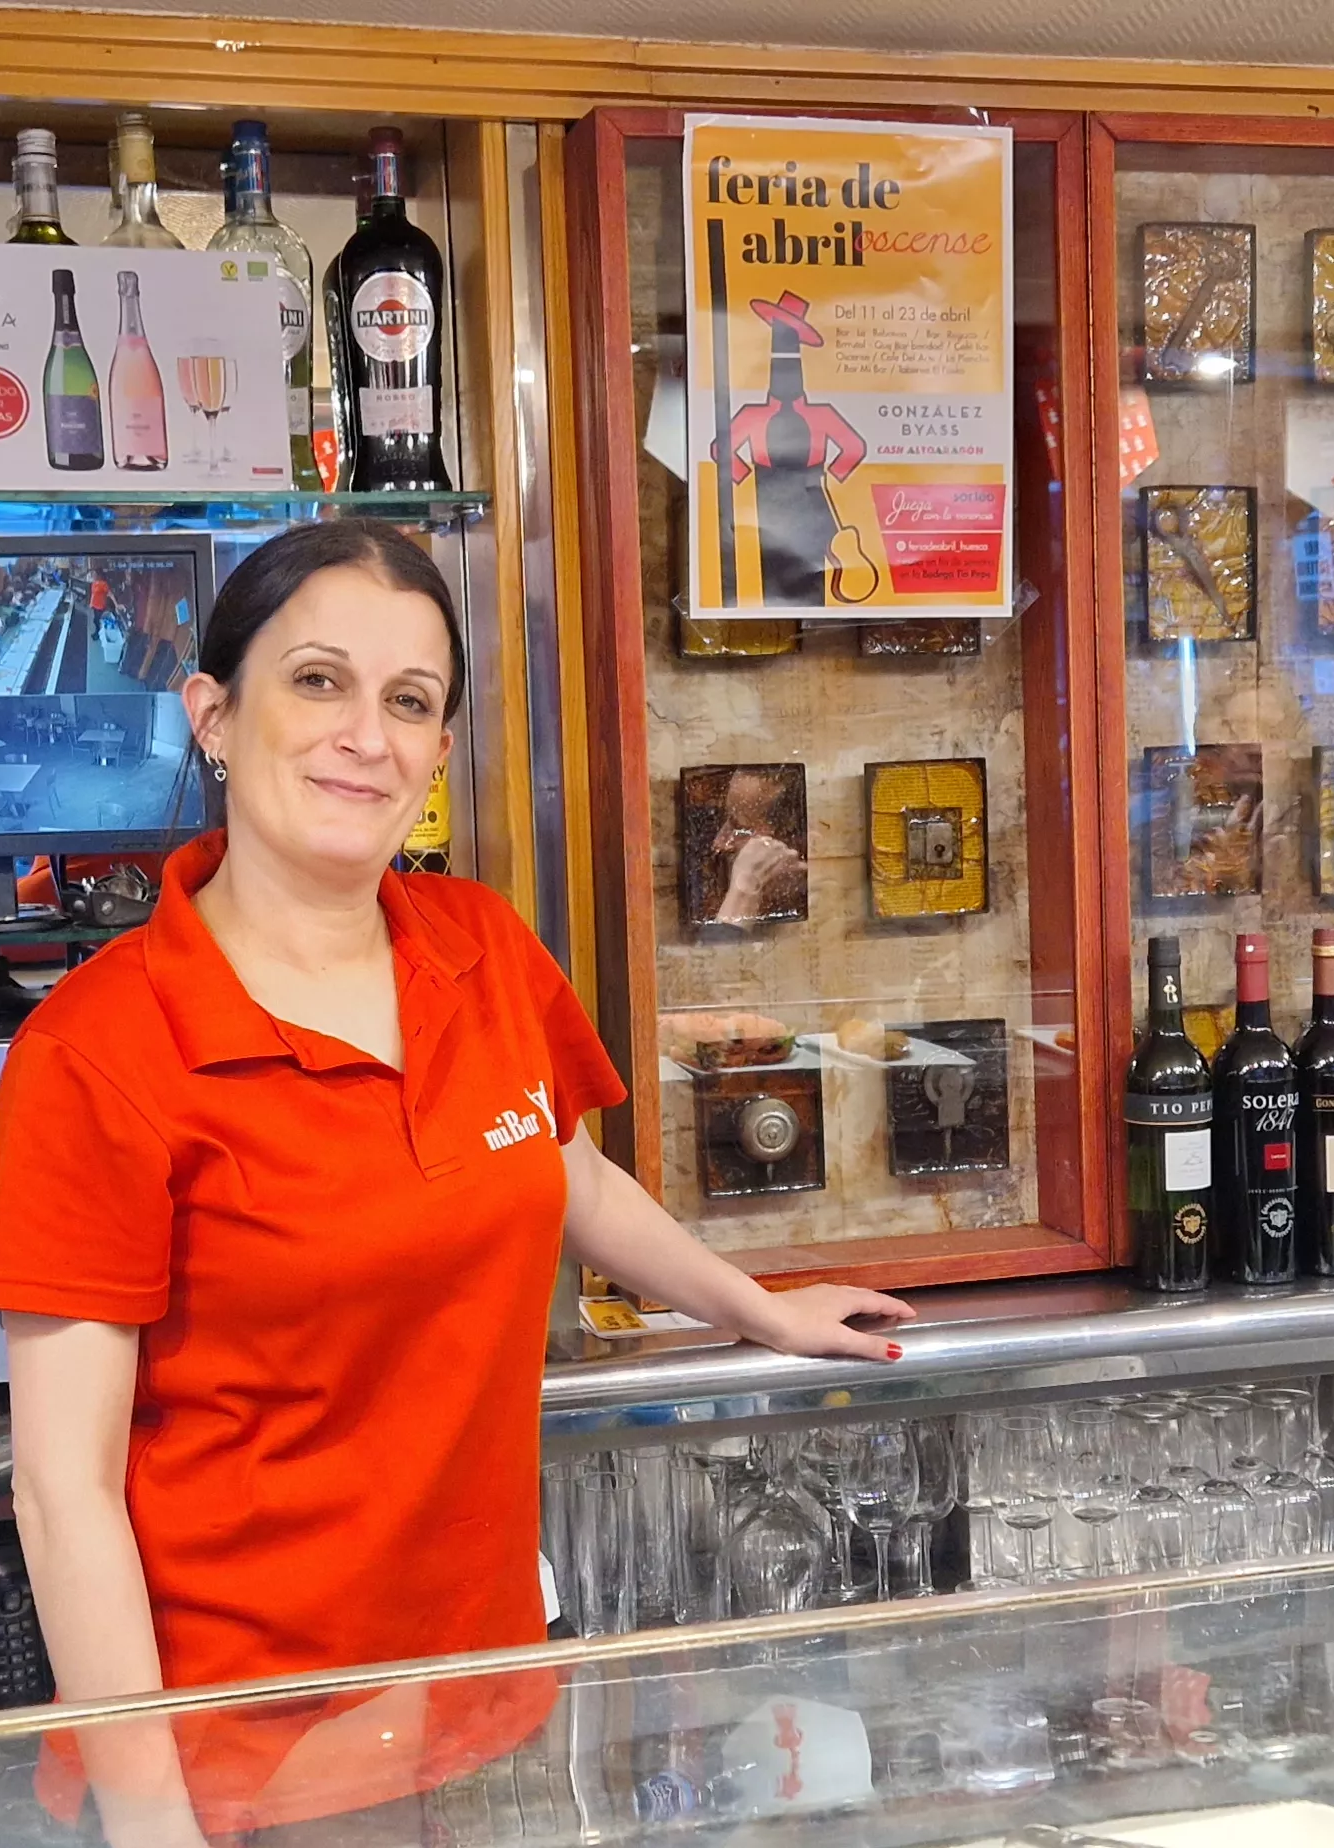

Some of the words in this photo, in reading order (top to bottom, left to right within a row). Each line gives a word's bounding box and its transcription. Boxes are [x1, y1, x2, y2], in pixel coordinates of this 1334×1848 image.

[705, 155, 831, 208] feria
[841, 162, 901, 210] de
[741, 218, 866, 267] abril
[853, 228, 992, 255] oscense
[358, 309, 427, 327] MARTINI
[835, 304, 856, 319] Del
[861, 305, 875, 319] 11
[882, 305, 894, 320] al
[898, 306, 916, 321] 23
[920, 306, 937, 321] de
[940, 306, 971, 322] abril
[878, 404, 983, 419] GONZÁLEZ
[901, 423, 960, 436] BYASS
[885, 490, 933, 526] Juega
[1150, 1102, 1183, 1115] TIO
[1191, 1099, 1213, 1114] PEP
[1255, 1108, 1296, 1132] 1847
